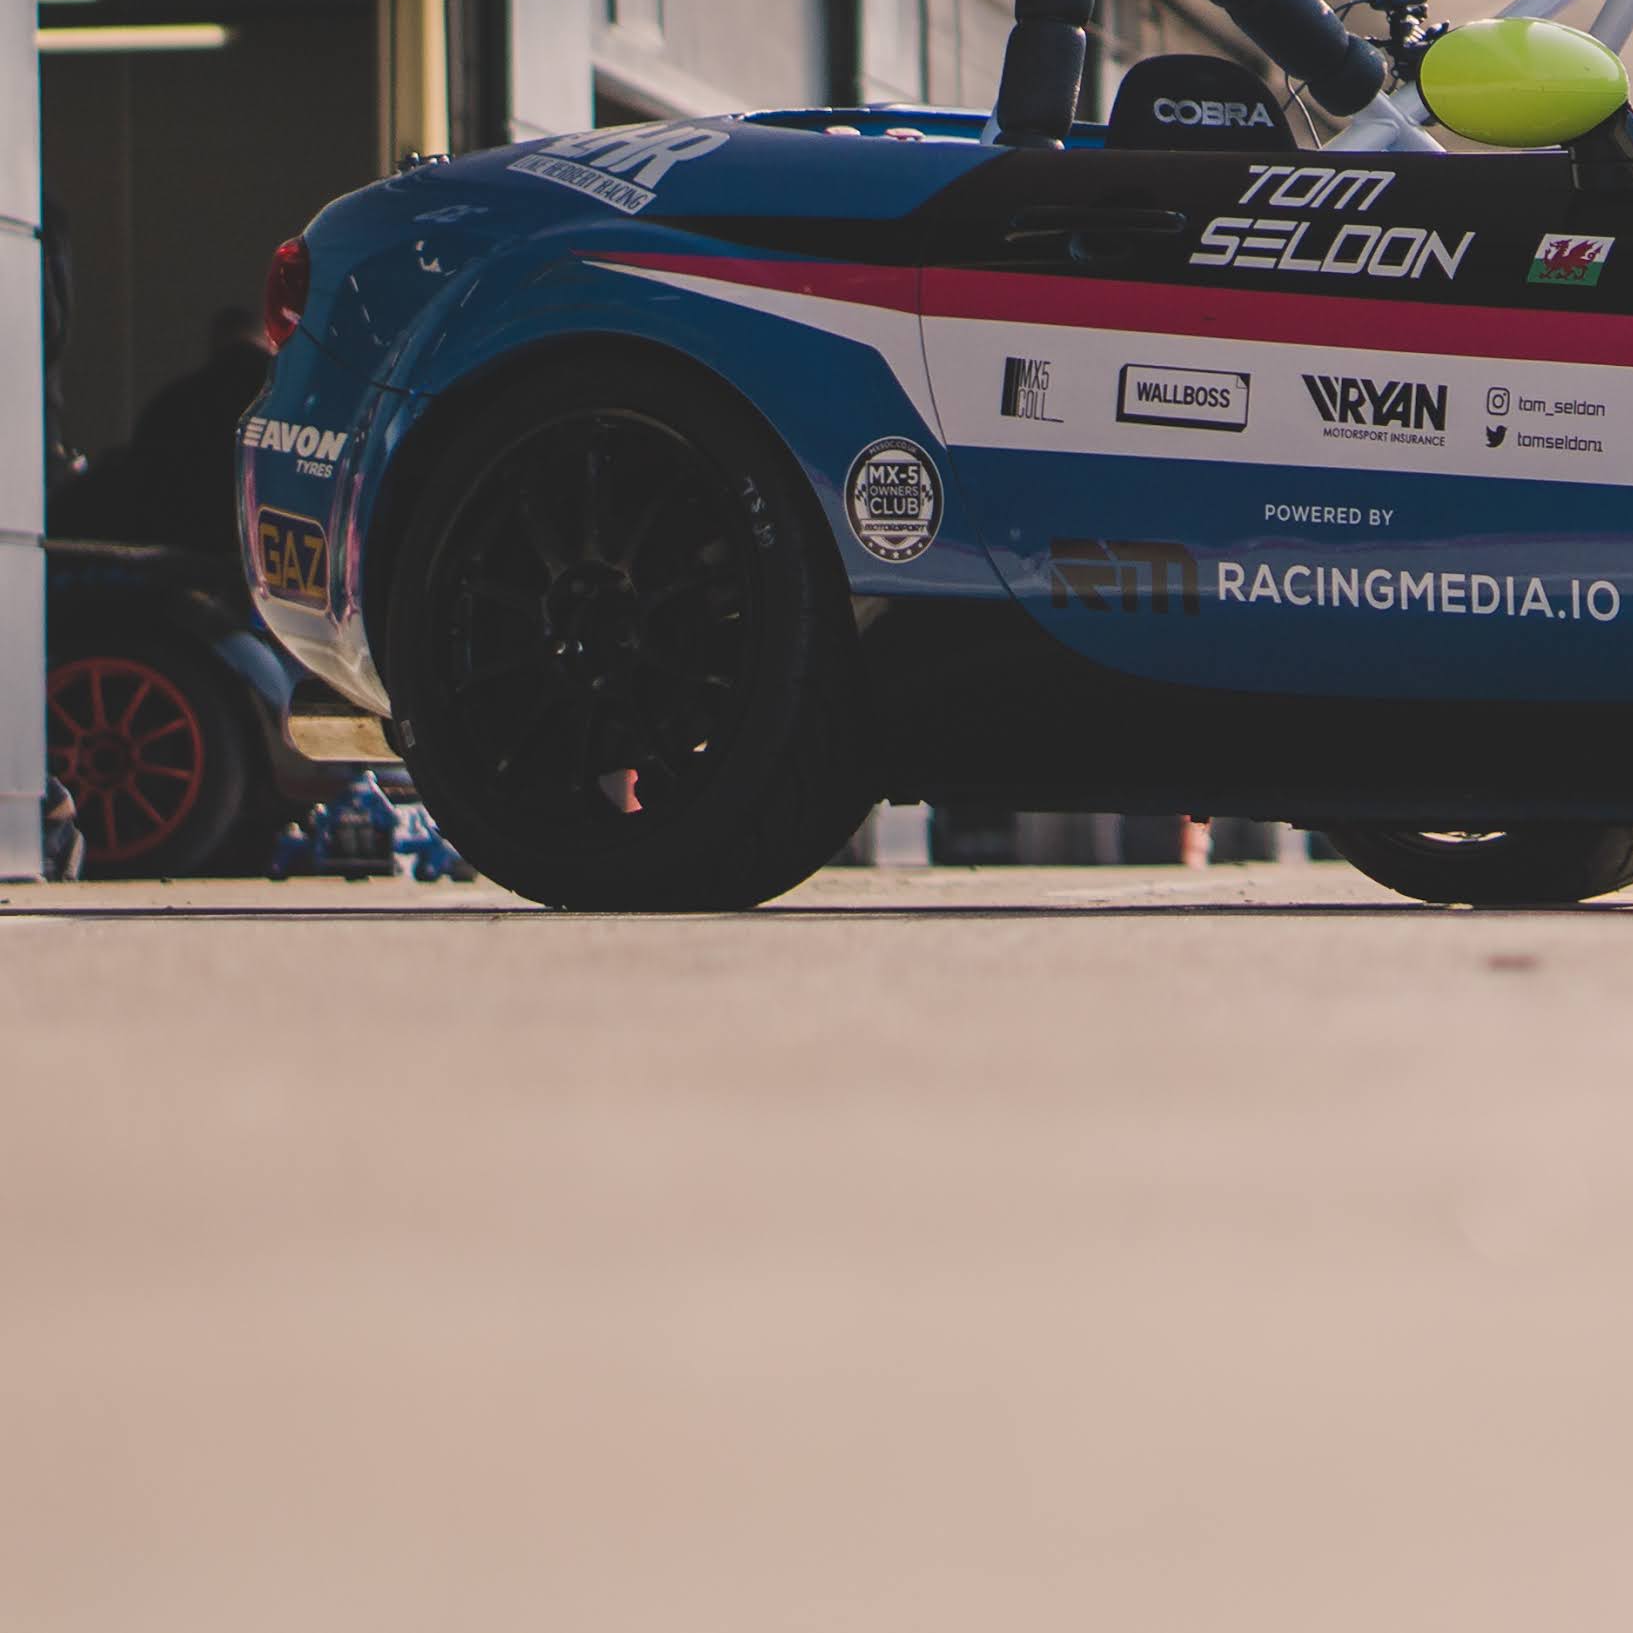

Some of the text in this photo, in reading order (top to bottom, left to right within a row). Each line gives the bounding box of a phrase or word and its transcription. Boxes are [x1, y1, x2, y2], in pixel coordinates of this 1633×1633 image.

[1153, 97, 1276, 128] COBRA
[592, 176, 648, 210] RACING
[1238, 165, 1396, 211] TOM
[1189, 217, 1476, 279] SELDON
[1018, 358, 1051, 390] MX5
[1137, 381, 1231, 409] WALLBOSS
[1518, 395, 1606, 417] tom_seldon
[260, 420, 348, 461] AVON
[1323, 427, 1446, 447] MOTORSPORT INSURANCE
[296, 459, 334, 478] TYRES
[869, 465, 919, 485] MX-5
[869, 485, 919, 497] OWNERS
[869, 497, 920, 515] CLUB
[1264, 504, 1395, 527] POWERED BY
[259, 522, 327, 601] GAZ
[1218, 561, 1621, 622] RACINGMEDIA.IO
